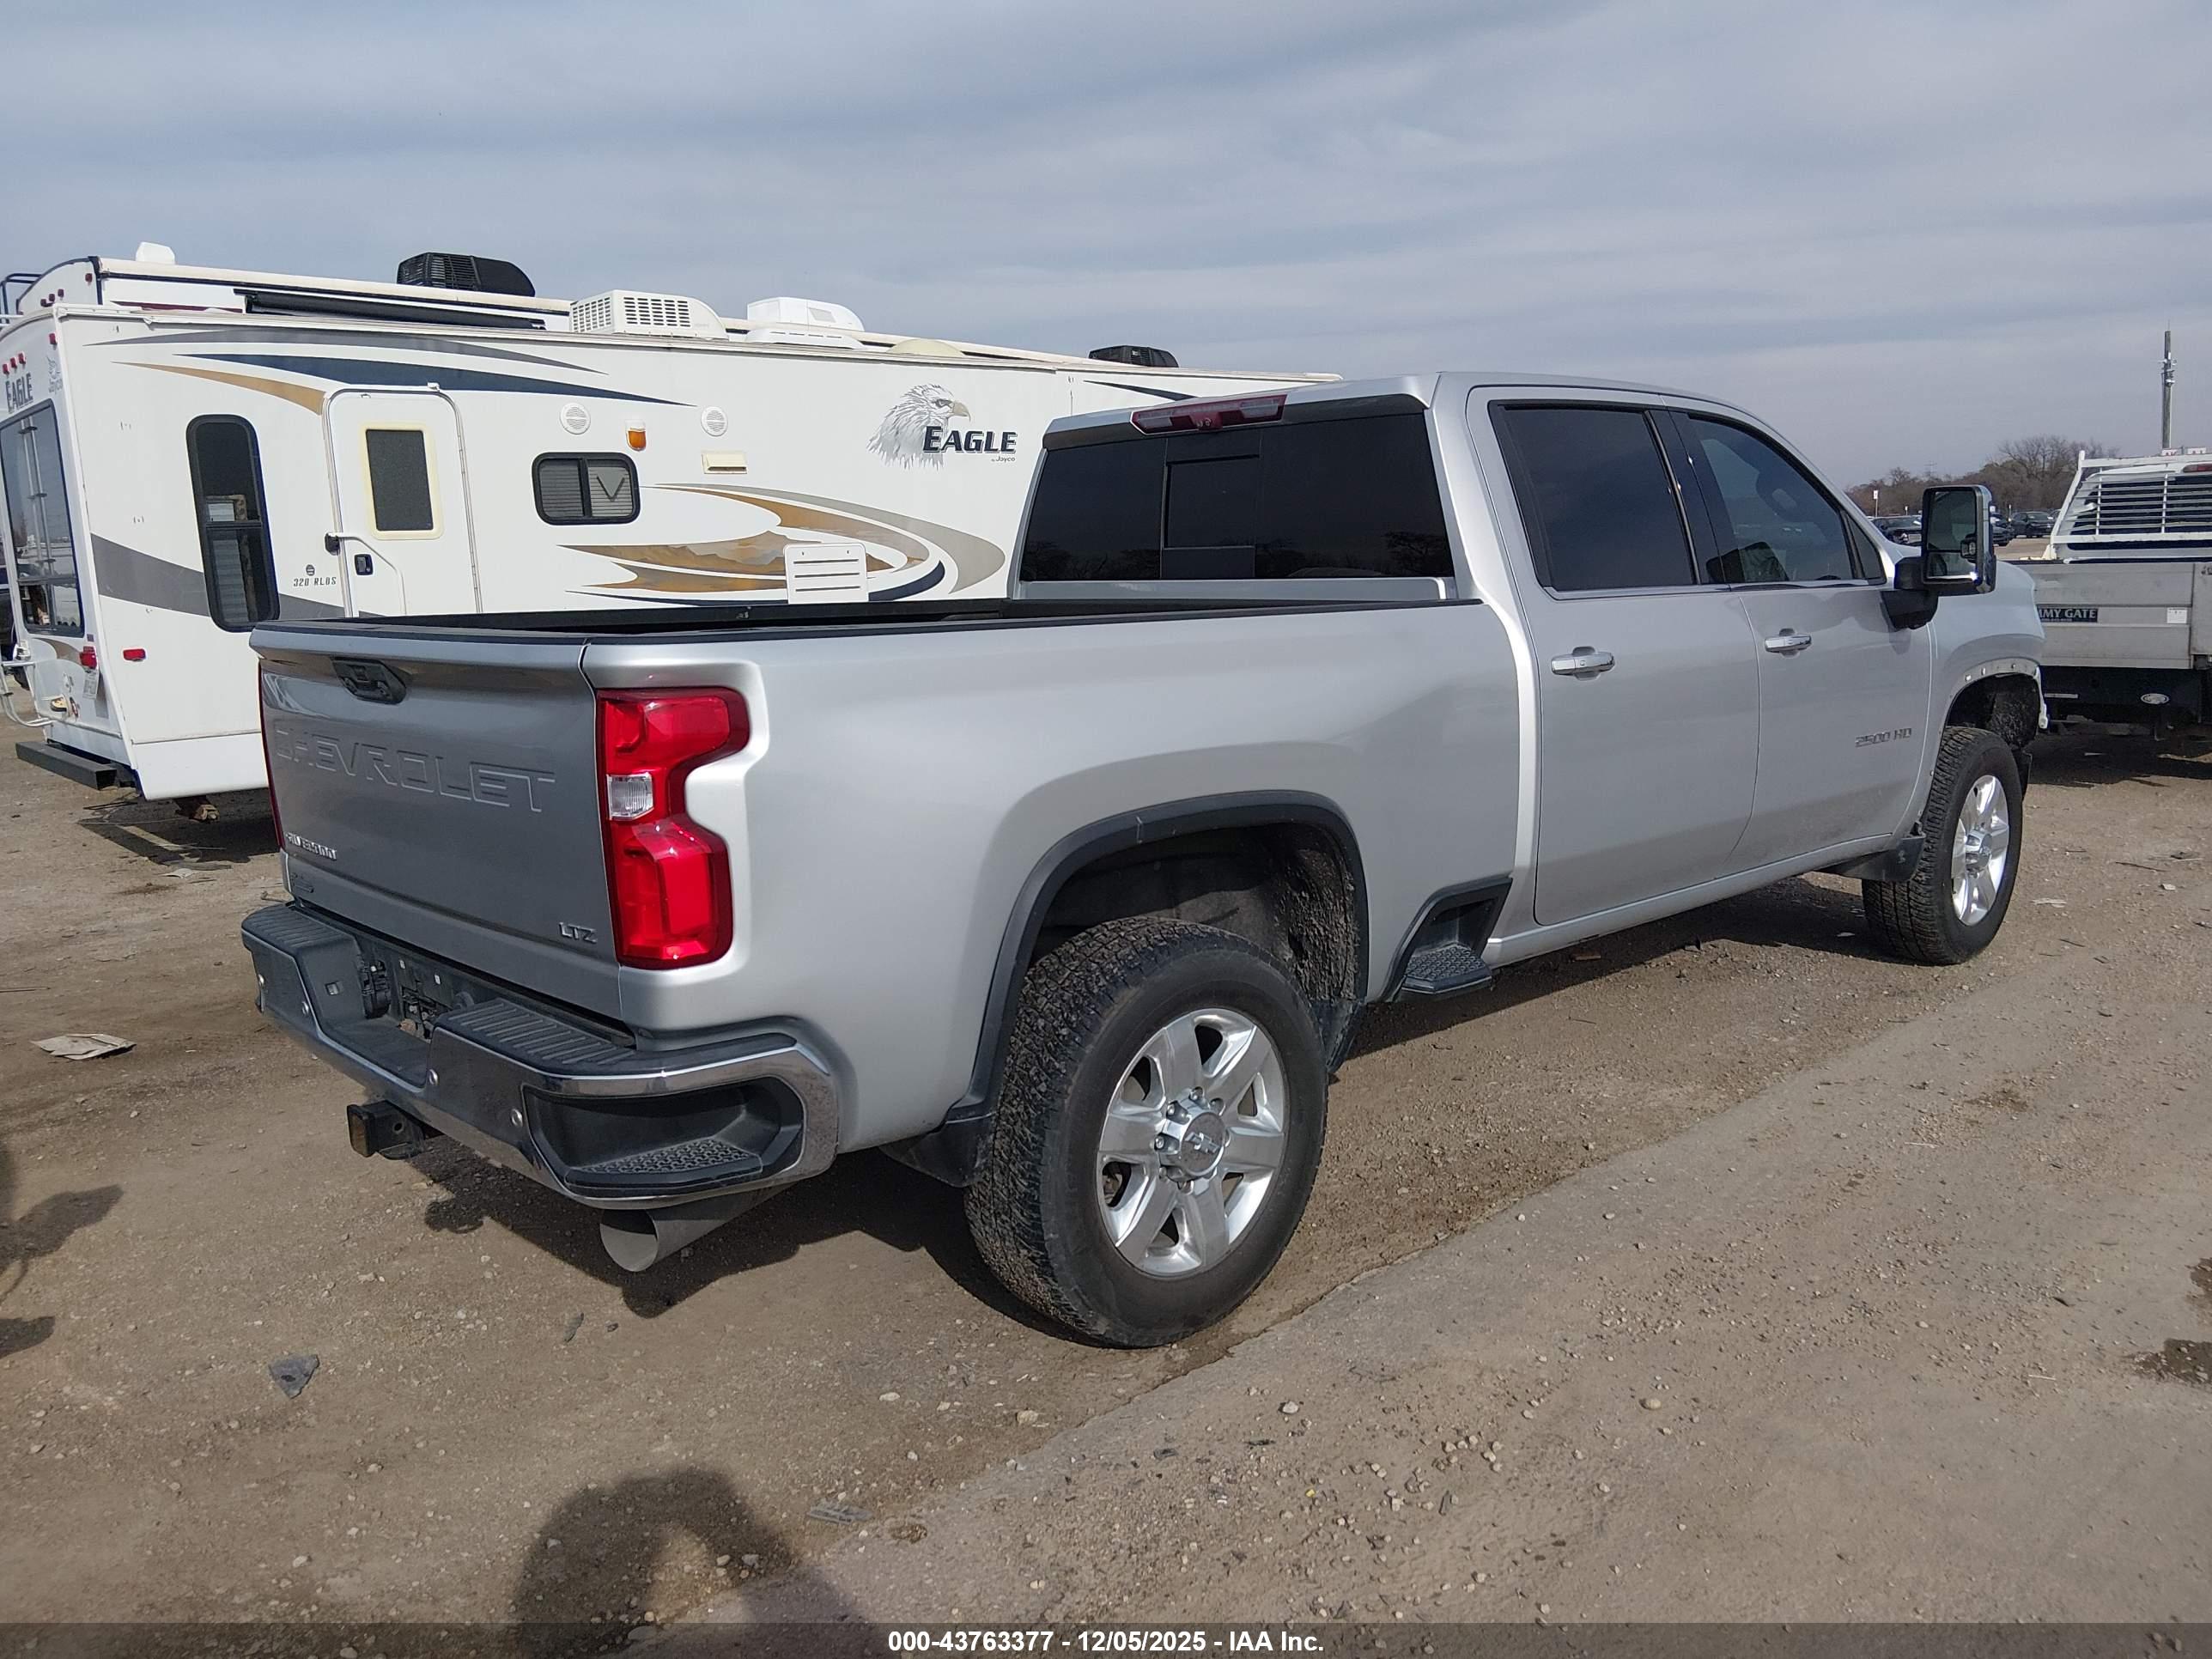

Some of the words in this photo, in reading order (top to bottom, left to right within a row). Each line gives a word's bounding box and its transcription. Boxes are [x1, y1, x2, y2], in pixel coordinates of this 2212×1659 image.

[5, 371, 33, 414] EAGLE
[922, 425, 1018, 453] EAGLE
[293, 578, 309, 587] 320
[2064, 608, 2096, 618] GATE
[1855, 732, 1891, 748] 2500
[1894, 727, 1911, 741] HD
[274, 719, 555, 812] CHEVROLET
[559, 921, 598, 944] LTZ
